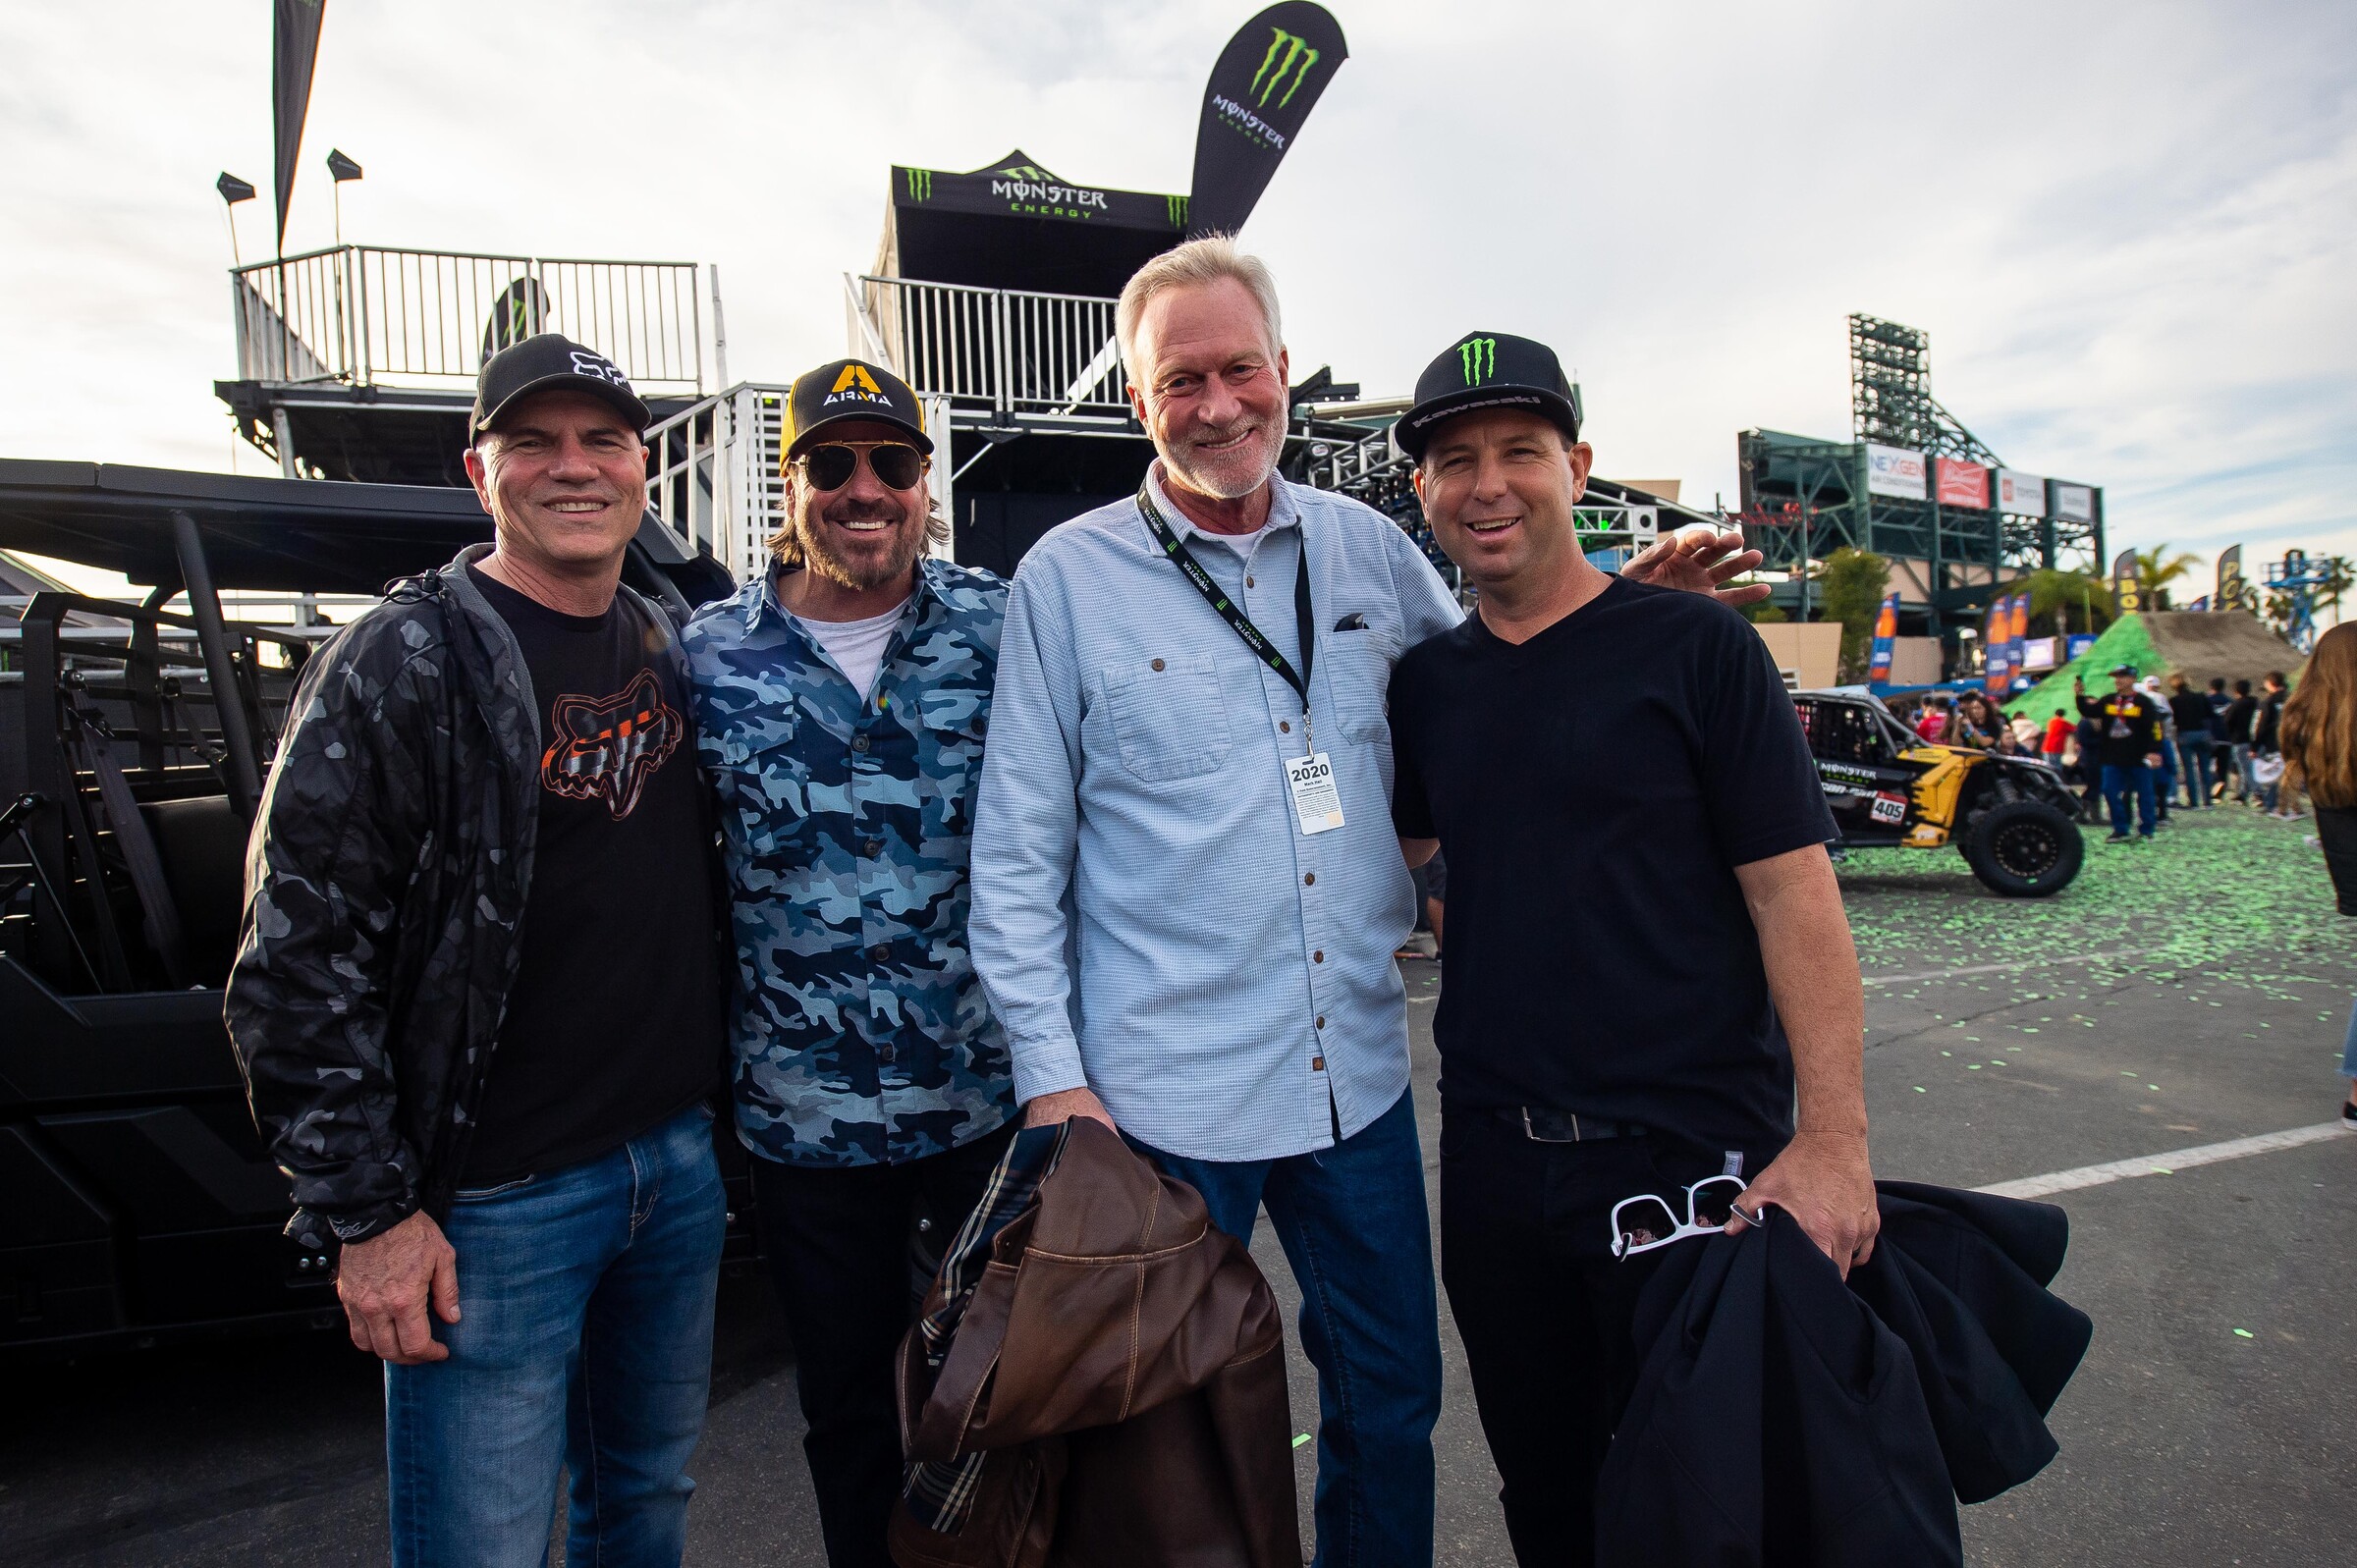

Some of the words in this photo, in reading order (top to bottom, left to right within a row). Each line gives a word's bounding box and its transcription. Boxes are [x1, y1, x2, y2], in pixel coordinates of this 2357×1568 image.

[1212, 93, 1286, 149] MONSTER
[992, 179, 1108, 209] MONSTER
[1011, 202, 1092, 219] ENERGY
[823, 391, 893, 407] ARMA
[1412, 396, 1541, 428] Kawasaki
[1144, 508, 1163, 535] MONSTER
[1182, 561, 1209, 592] MONSTER
[1233, 620, 1263, 650] MONSTER
[1291, 764, 1329, 783] 2020
[1820, 762, 1877, 780] MONSTER
[1875, 801, 1902, 819] 405
